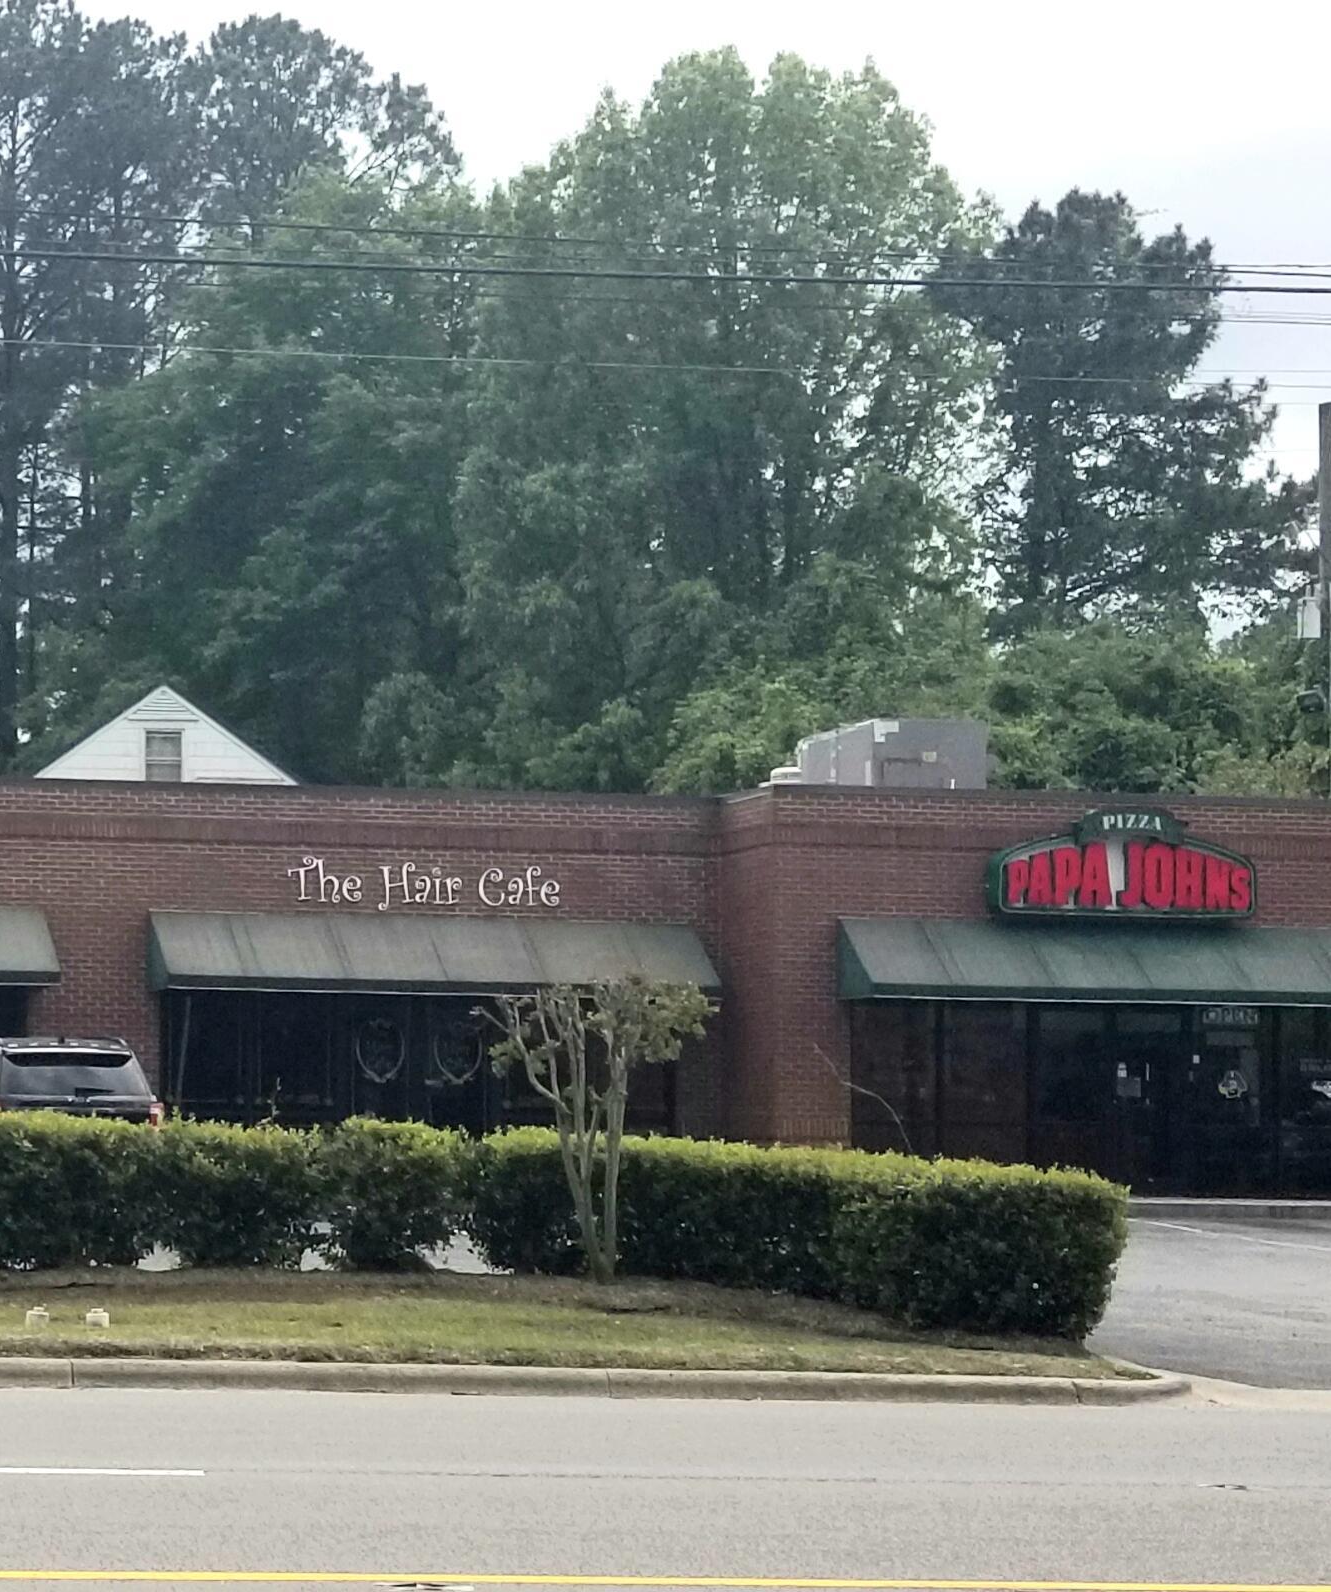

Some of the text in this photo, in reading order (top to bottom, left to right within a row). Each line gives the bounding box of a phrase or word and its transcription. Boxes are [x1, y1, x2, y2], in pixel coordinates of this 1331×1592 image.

[1102, 813, 1162, 831] PIZZA
[287, 855, 561, 911] The Hair Cafe
[1007, 841, 1251, 911] PAPA JOHNS
